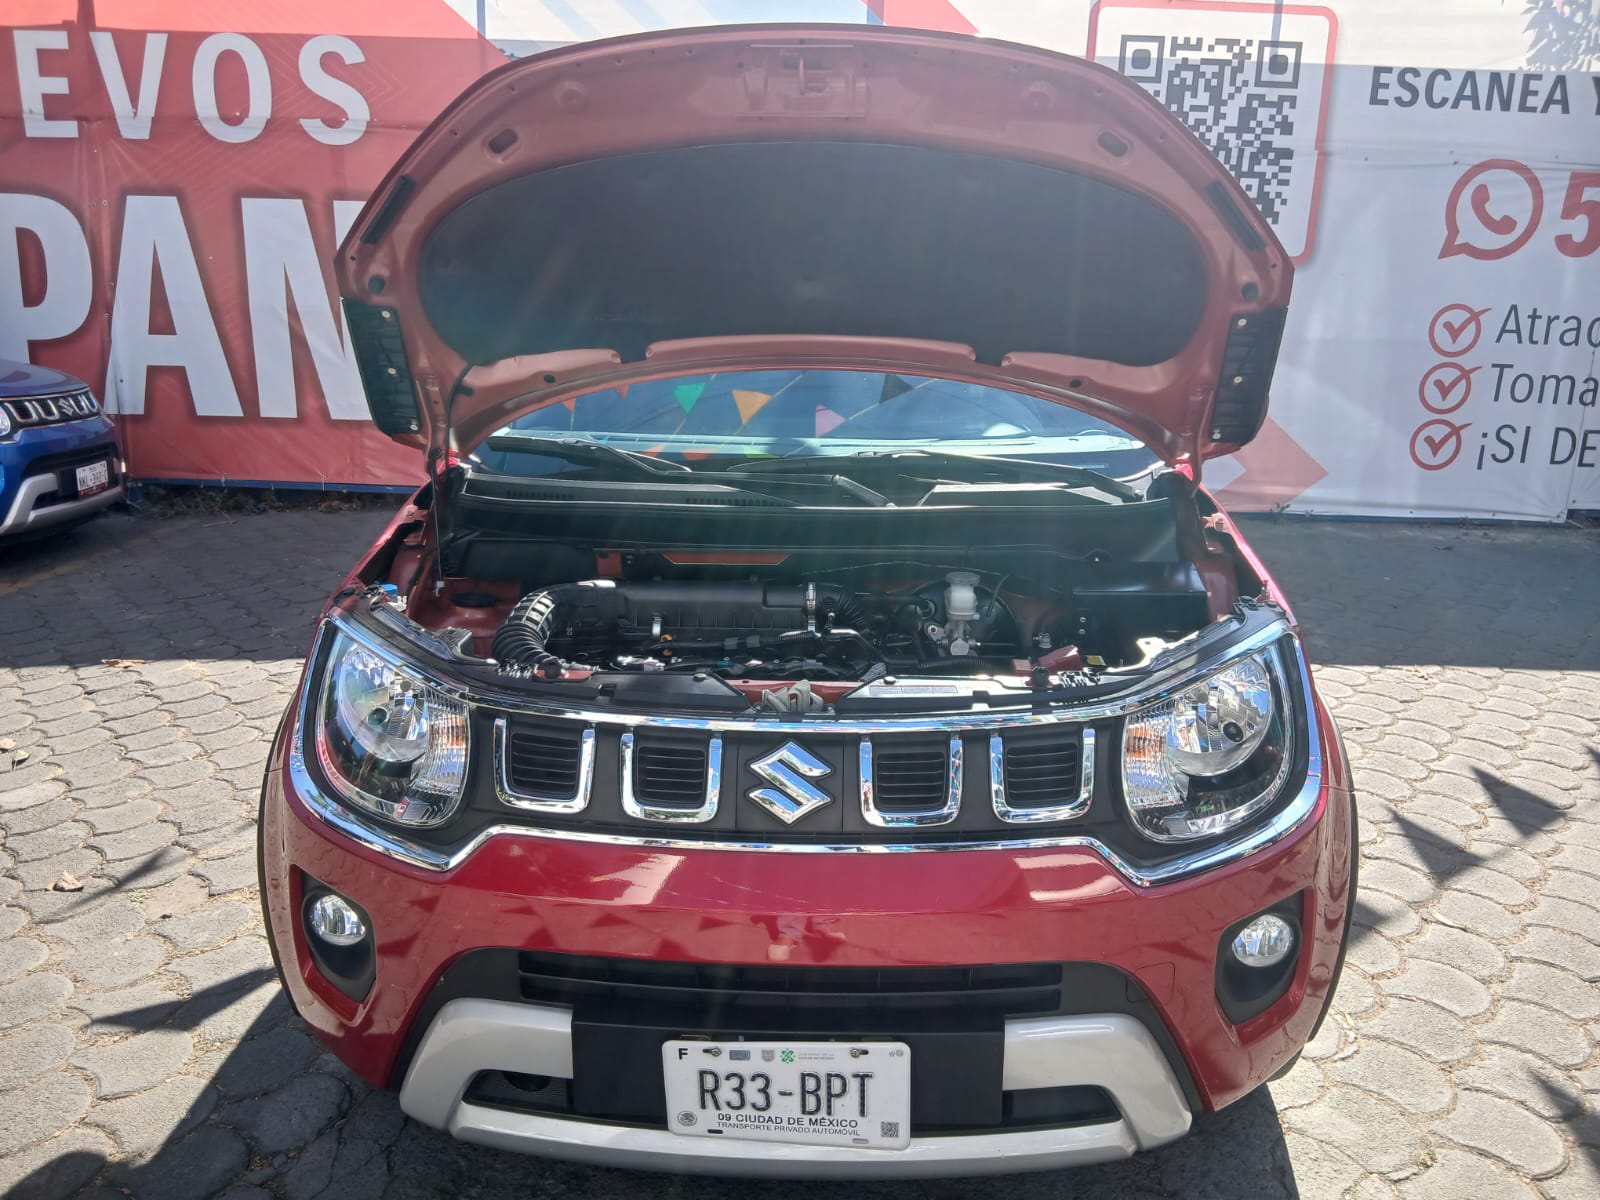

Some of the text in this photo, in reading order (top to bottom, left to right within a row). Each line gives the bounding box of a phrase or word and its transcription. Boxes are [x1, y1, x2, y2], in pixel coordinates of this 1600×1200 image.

[13, 29, 371, 145] EVOS
[1369, 66, 1570, 114] ESCANEA
[1554, 171, 1600, 257] 5
[1491, 363, 1600, 407] Toma
[1549, 427, 1600, 468] DE
[678, 1047, 689, 1060] F
[698, 1069, 873, 1117] R33-BPT
[717, 1112, 858, 1128] 09 CIUDAD DE MÉXICO
[717, 1121, 773, 1131] TRANSPORTE
[774, 1125, 810, 1134] PRIVADO
